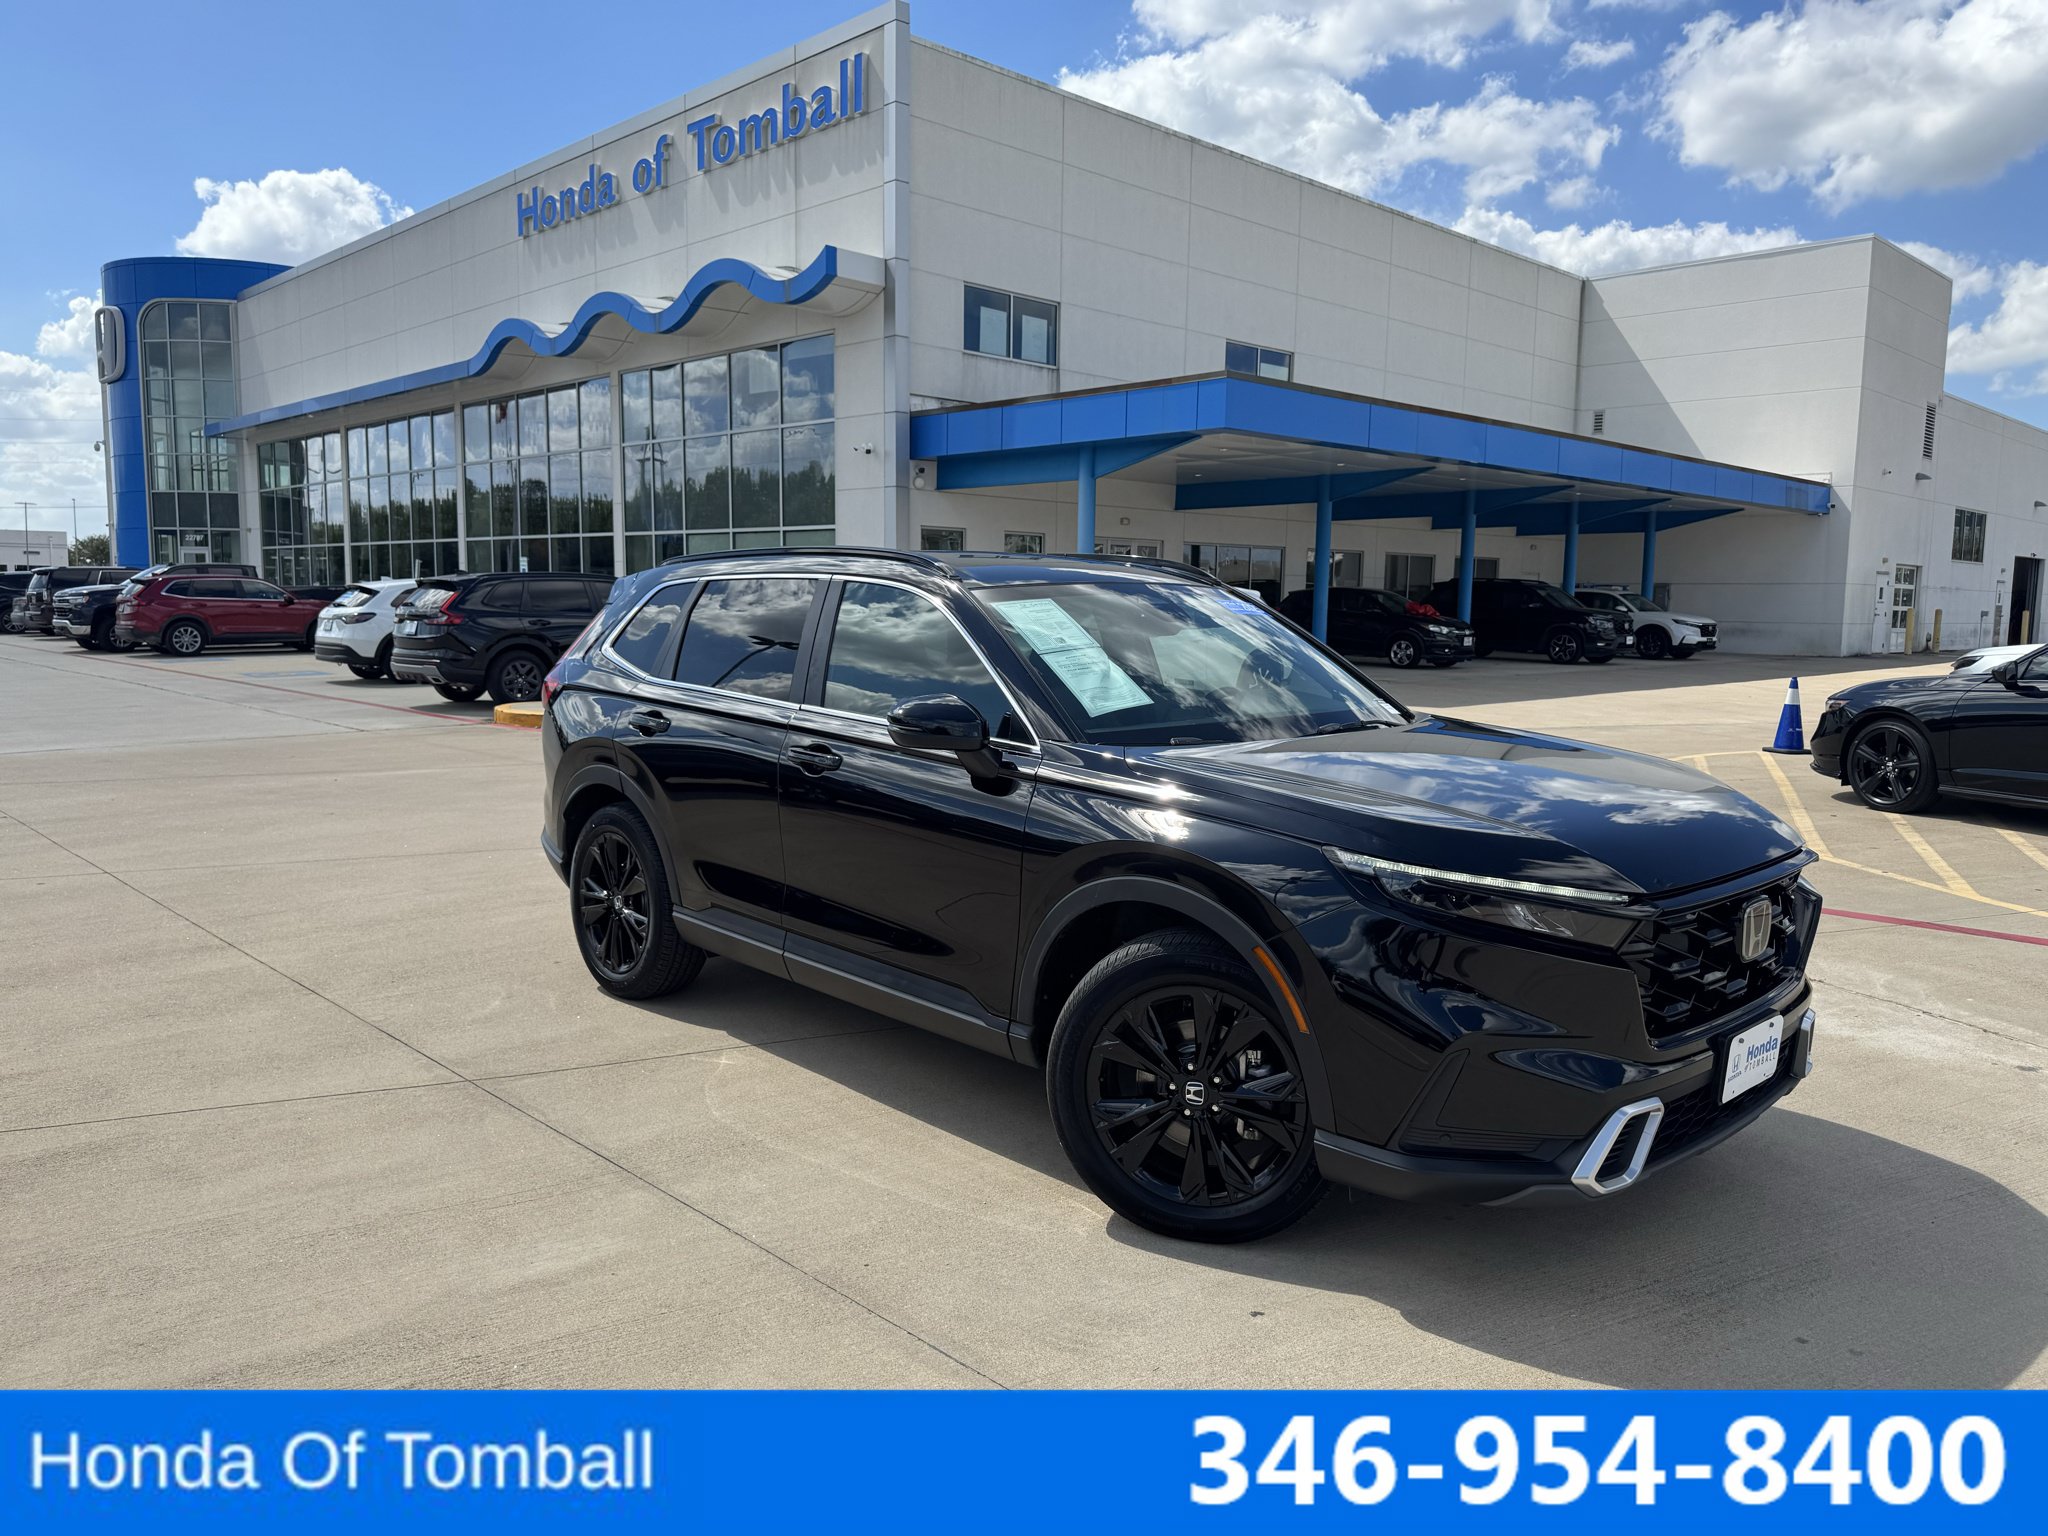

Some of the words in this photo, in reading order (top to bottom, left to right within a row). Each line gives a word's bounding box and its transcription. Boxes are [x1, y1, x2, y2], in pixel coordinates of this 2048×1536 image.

[517, 163, 619, 238] Honda
[632, 133, 673, 194] of
[687, 52, 868, 173] Tomball
[1746, 1036, 1778, 1063] Honda
